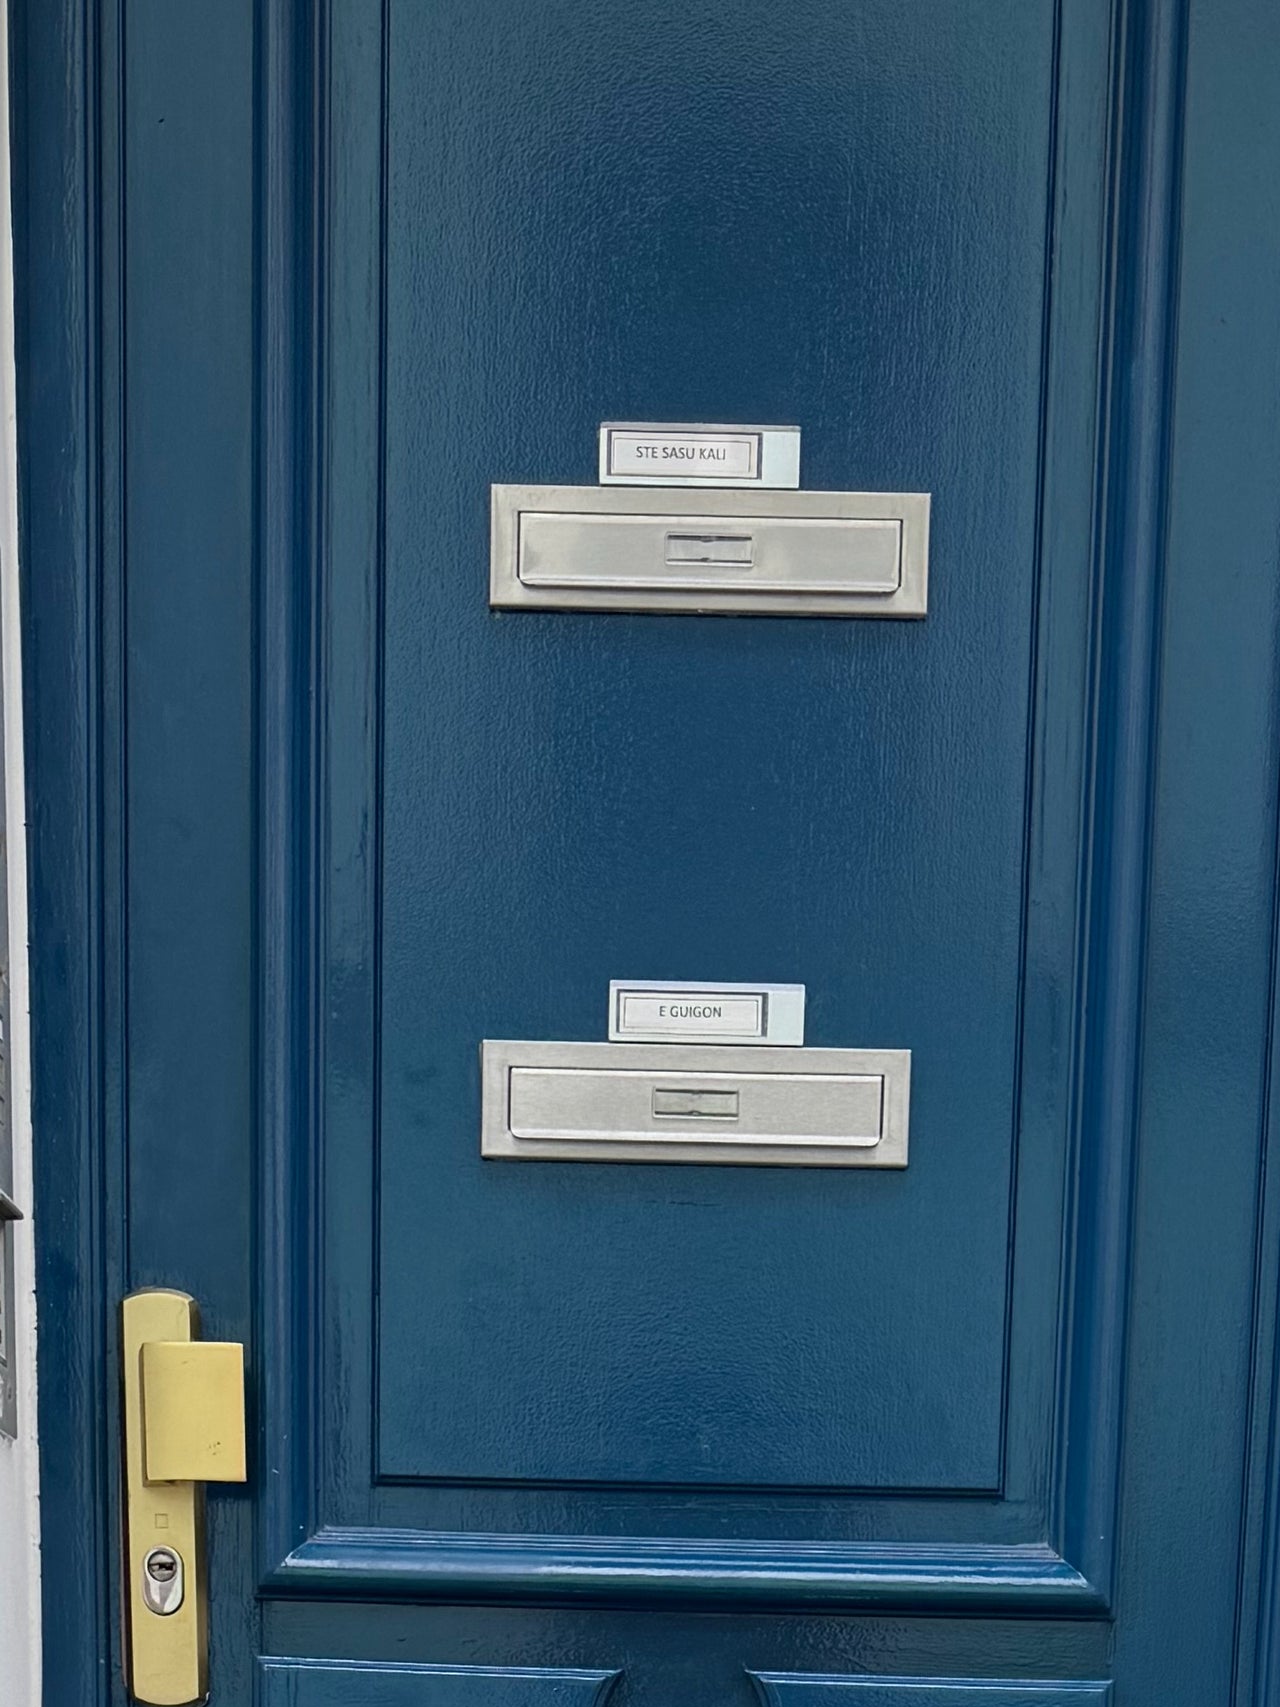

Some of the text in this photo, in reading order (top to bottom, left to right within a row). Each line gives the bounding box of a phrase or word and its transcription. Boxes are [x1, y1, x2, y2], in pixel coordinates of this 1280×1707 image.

[636, 446, 658, 459] STE
[662, 447, 695, 460] SASU
[659, 1005, 722, 1018] E GUIGON
